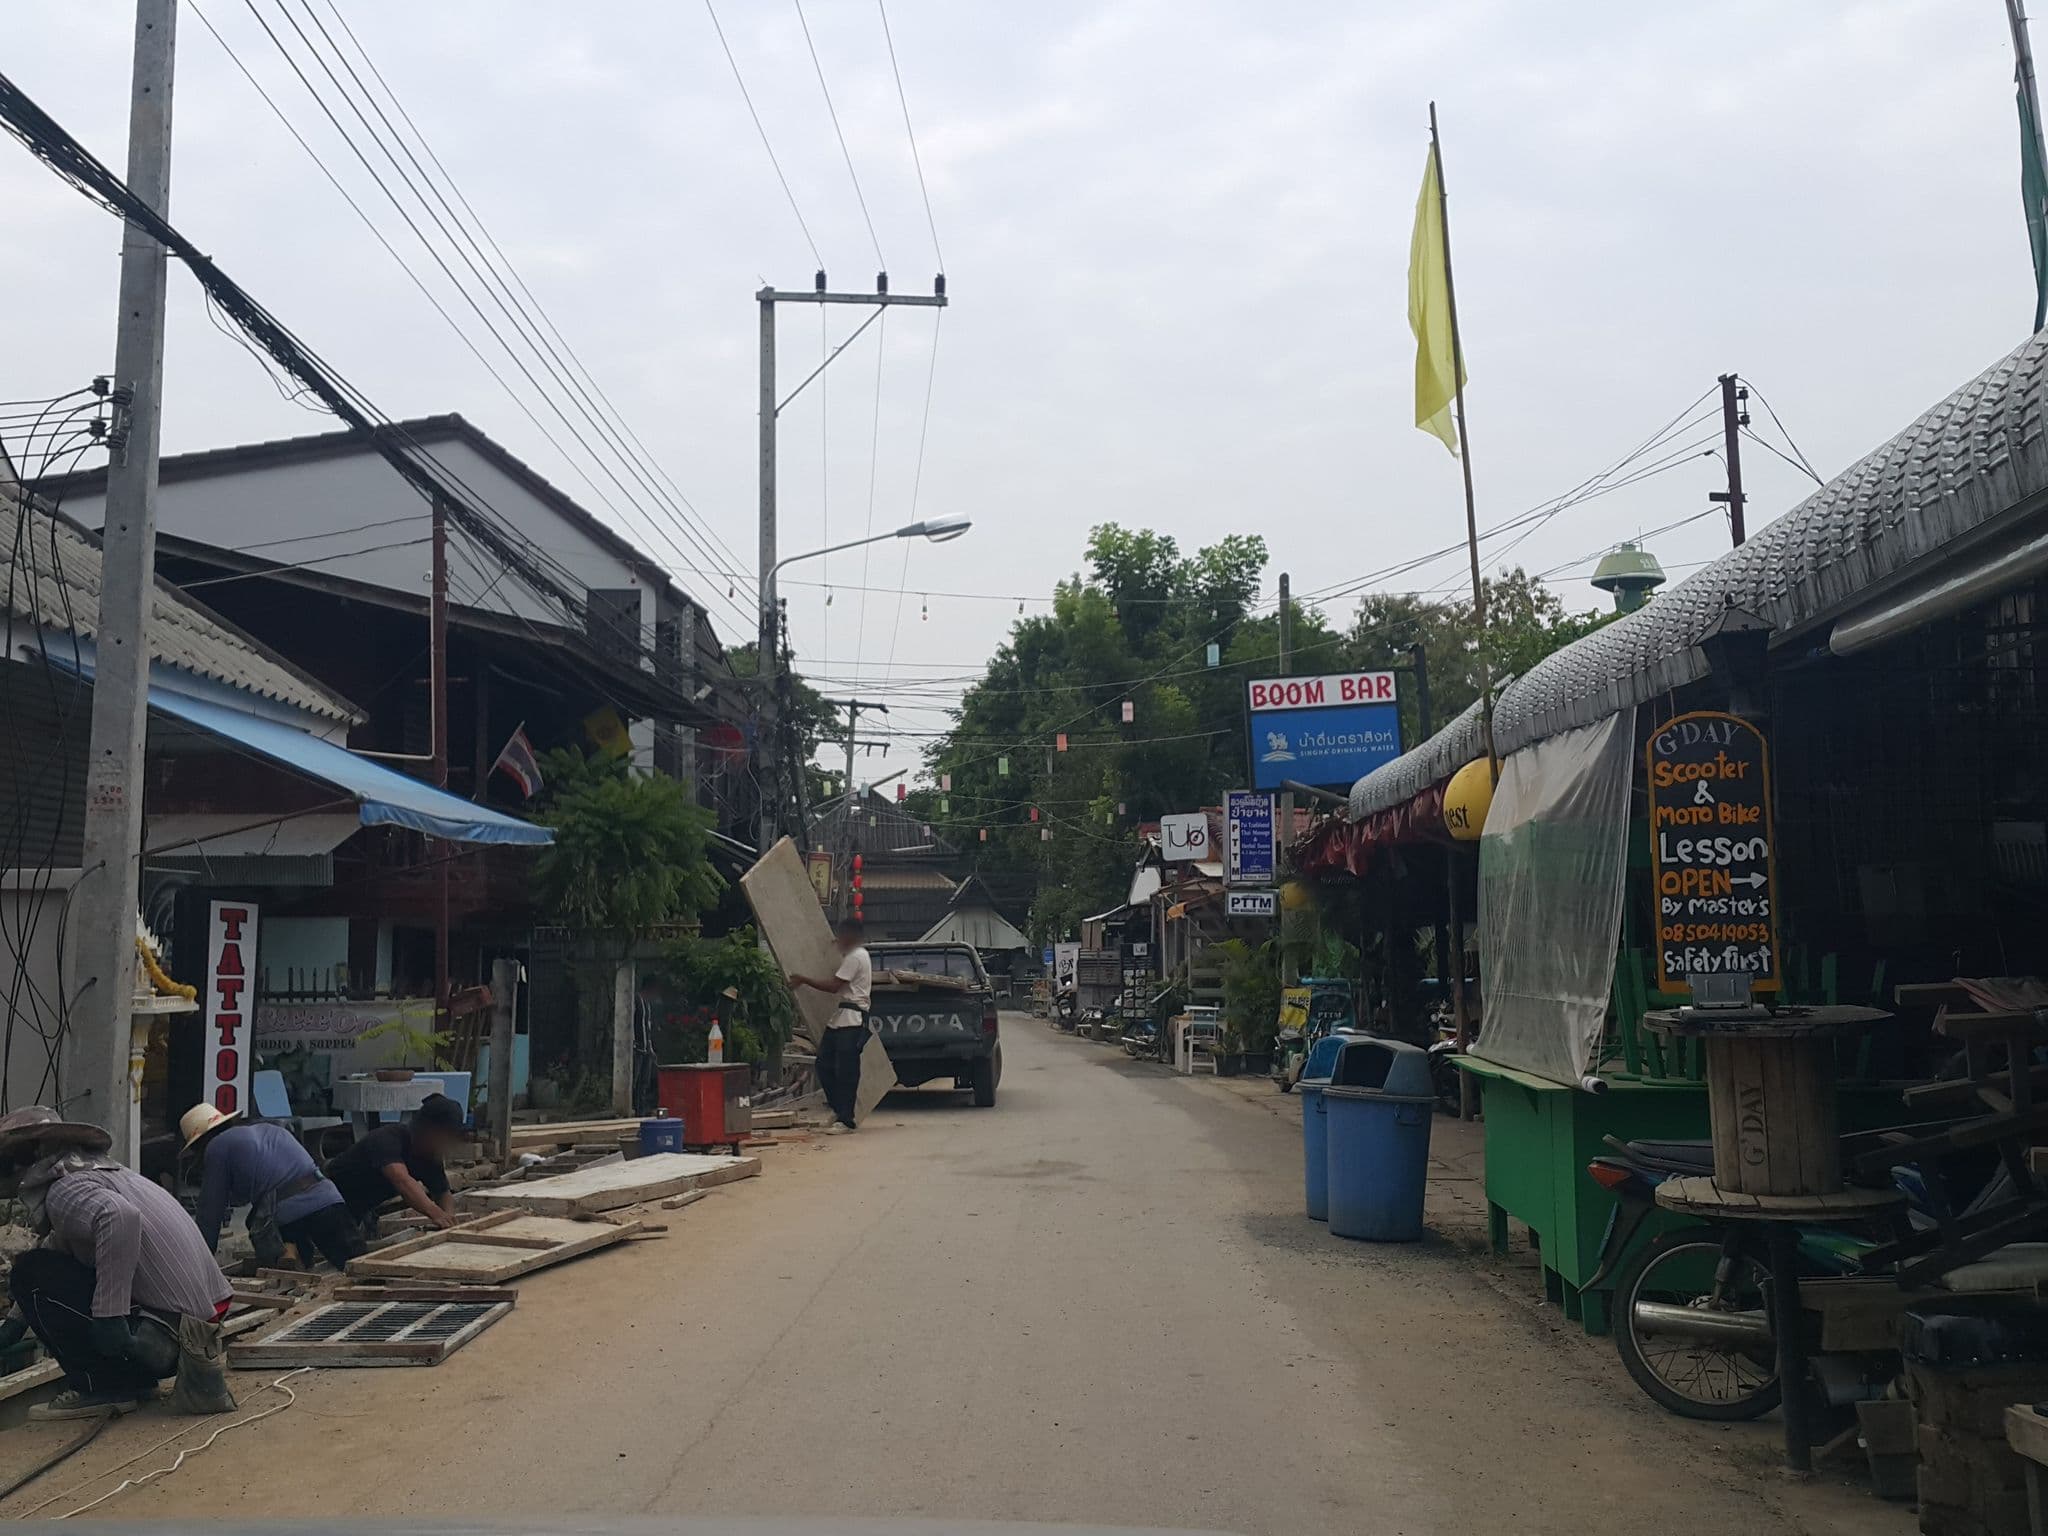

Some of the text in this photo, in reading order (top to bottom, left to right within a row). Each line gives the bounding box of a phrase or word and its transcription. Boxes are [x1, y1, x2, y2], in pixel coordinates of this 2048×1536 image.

[1252, 675, 1393, 708] BOOM BAR
[1300, 744, 1395, 757] SINGHA DRINKING WATER
[1656, 722, 1740, 755] G'DAY
[1655, 750, 1749, 787] Scooter
[1693, 779, 1715, 804] &
[1718, 801, 1760, 825] Bike
[1660, 832, 1769, 865] Lesson
[1660, 867, 1732, 897] OPEN
[1232, 898, 1271, 908] PTTM
[1661, 897, 1682, 916] By
[215, 908, 248, 1115] TATTOO
